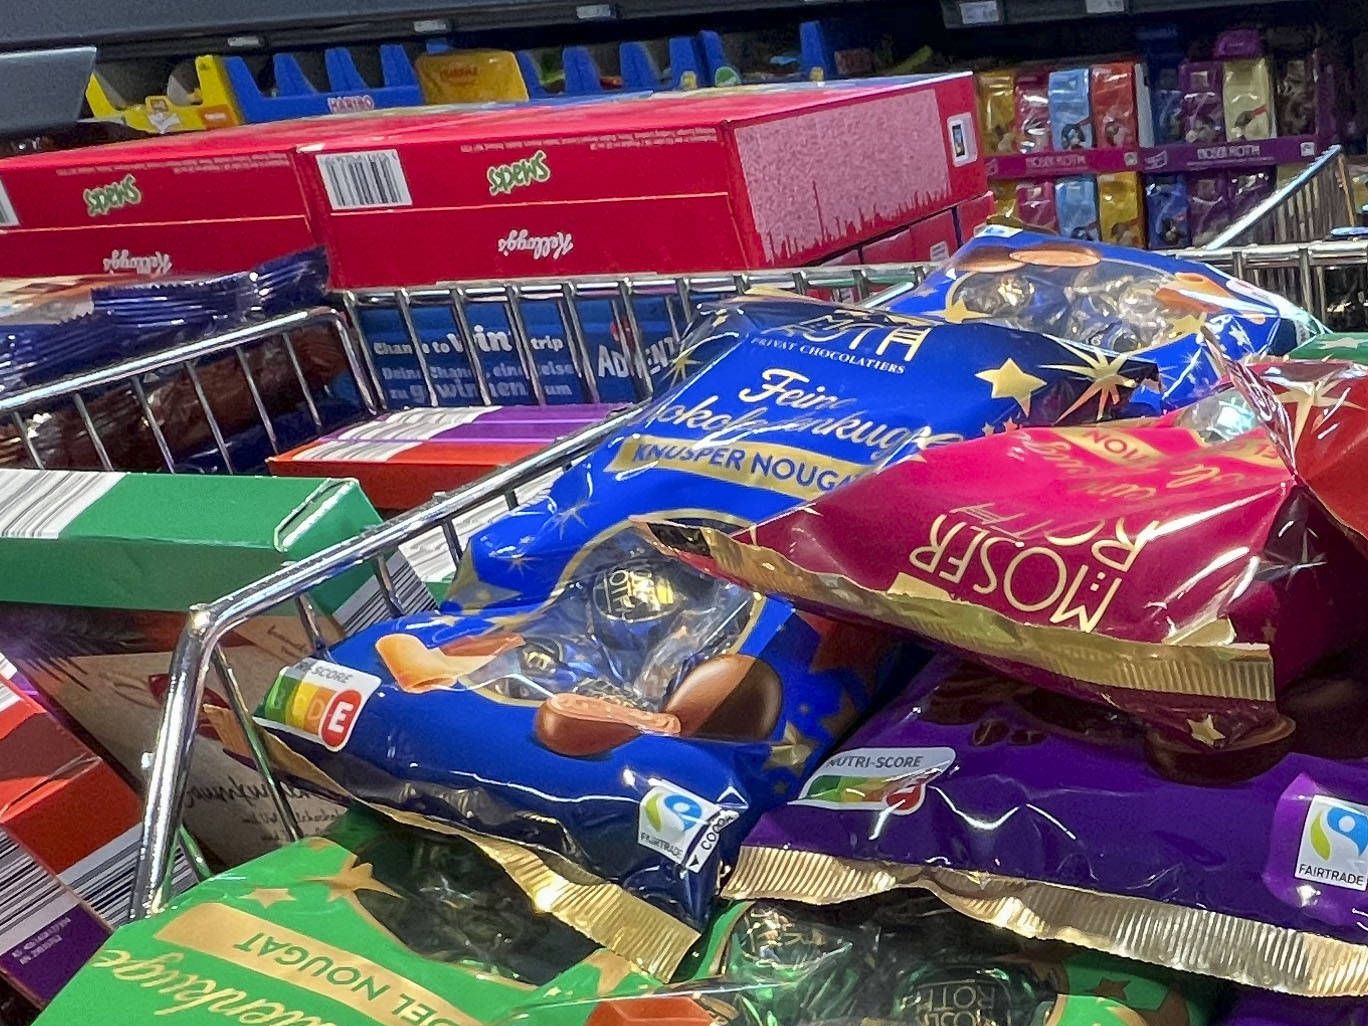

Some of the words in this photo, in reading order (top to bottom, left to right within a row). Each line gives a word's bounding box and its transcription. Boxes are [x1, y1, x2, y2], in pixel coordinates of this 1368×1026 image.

[486, 150, 550, 196] Smacks
[84, 174, 142, 217] Smacks
[498, 229, 574, 259] Kellogg's
[103, 249, 173, 275] Kellogg's
[530, 335, 564, 352] trip
[799, 343, 906, 375] CHOCOLATIERS
[908, 513, 1122, 634] MOSER
[328, 701, 354, 733] E
[1298, 863, 1365, 887] FAIRTRADE
[234, 932, 392, 1001] NOUGAT
